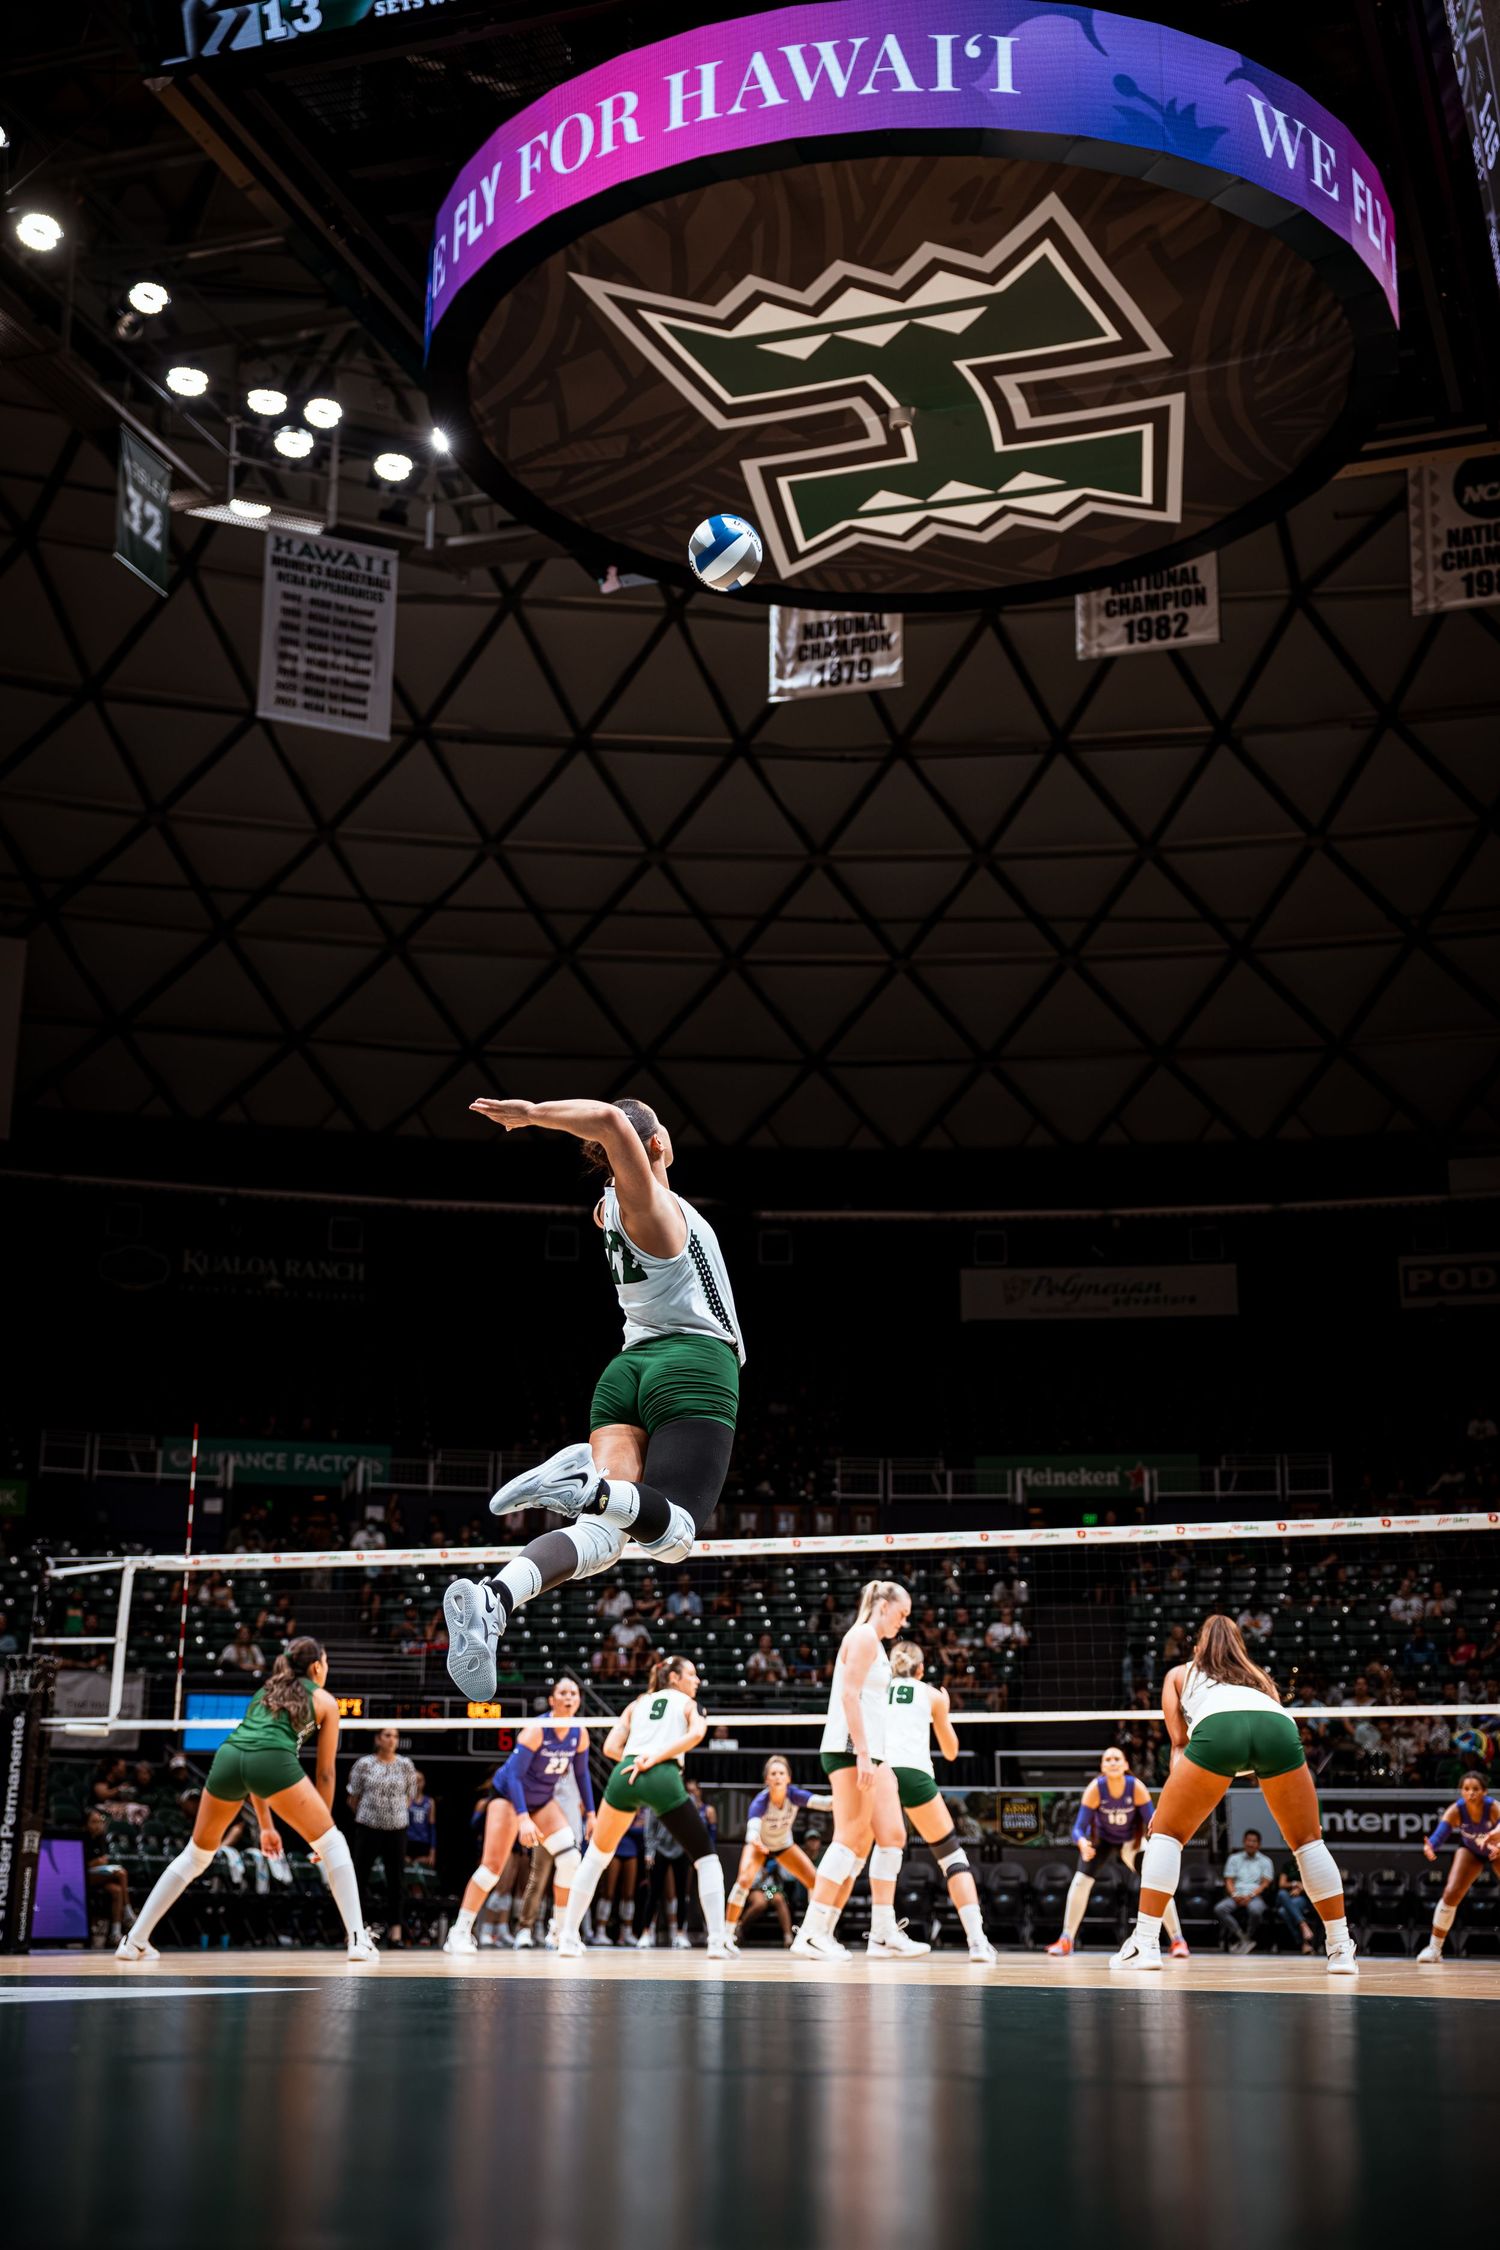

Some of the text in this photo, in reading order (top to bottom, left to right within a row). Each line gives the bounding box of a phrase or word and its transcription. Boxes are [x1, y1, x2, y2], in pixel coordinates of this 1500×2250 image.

[262, 0, 323, 40] 13
[1246, 94, 1339, 202] WE
[1352, 167, 1386, 263] FLY
[431, 234, 447, 299] E
[452, 161, 502, 264] FLY
[515, 91, 645, 203] FOR
[273, 535, 391, 576] HAWAII
[1104, 587, 1206, 618] CHAMPION
[803, 613, 886, 640] NATIONAL
[1123, 612, 1189, 644] 1982
[798, 633, 893, 662] CHAMPION
[284, 1259, 366, 1282] RANCH
[1407, 1266, 1498, 1293] POD
[1030, 1273, 1164, 1304] Polynesian
[649, 1698, 668, 1720] 9
[888, 1686, 914, 1705] 19
[1322, 1806, 1447, 1840] nterpri
